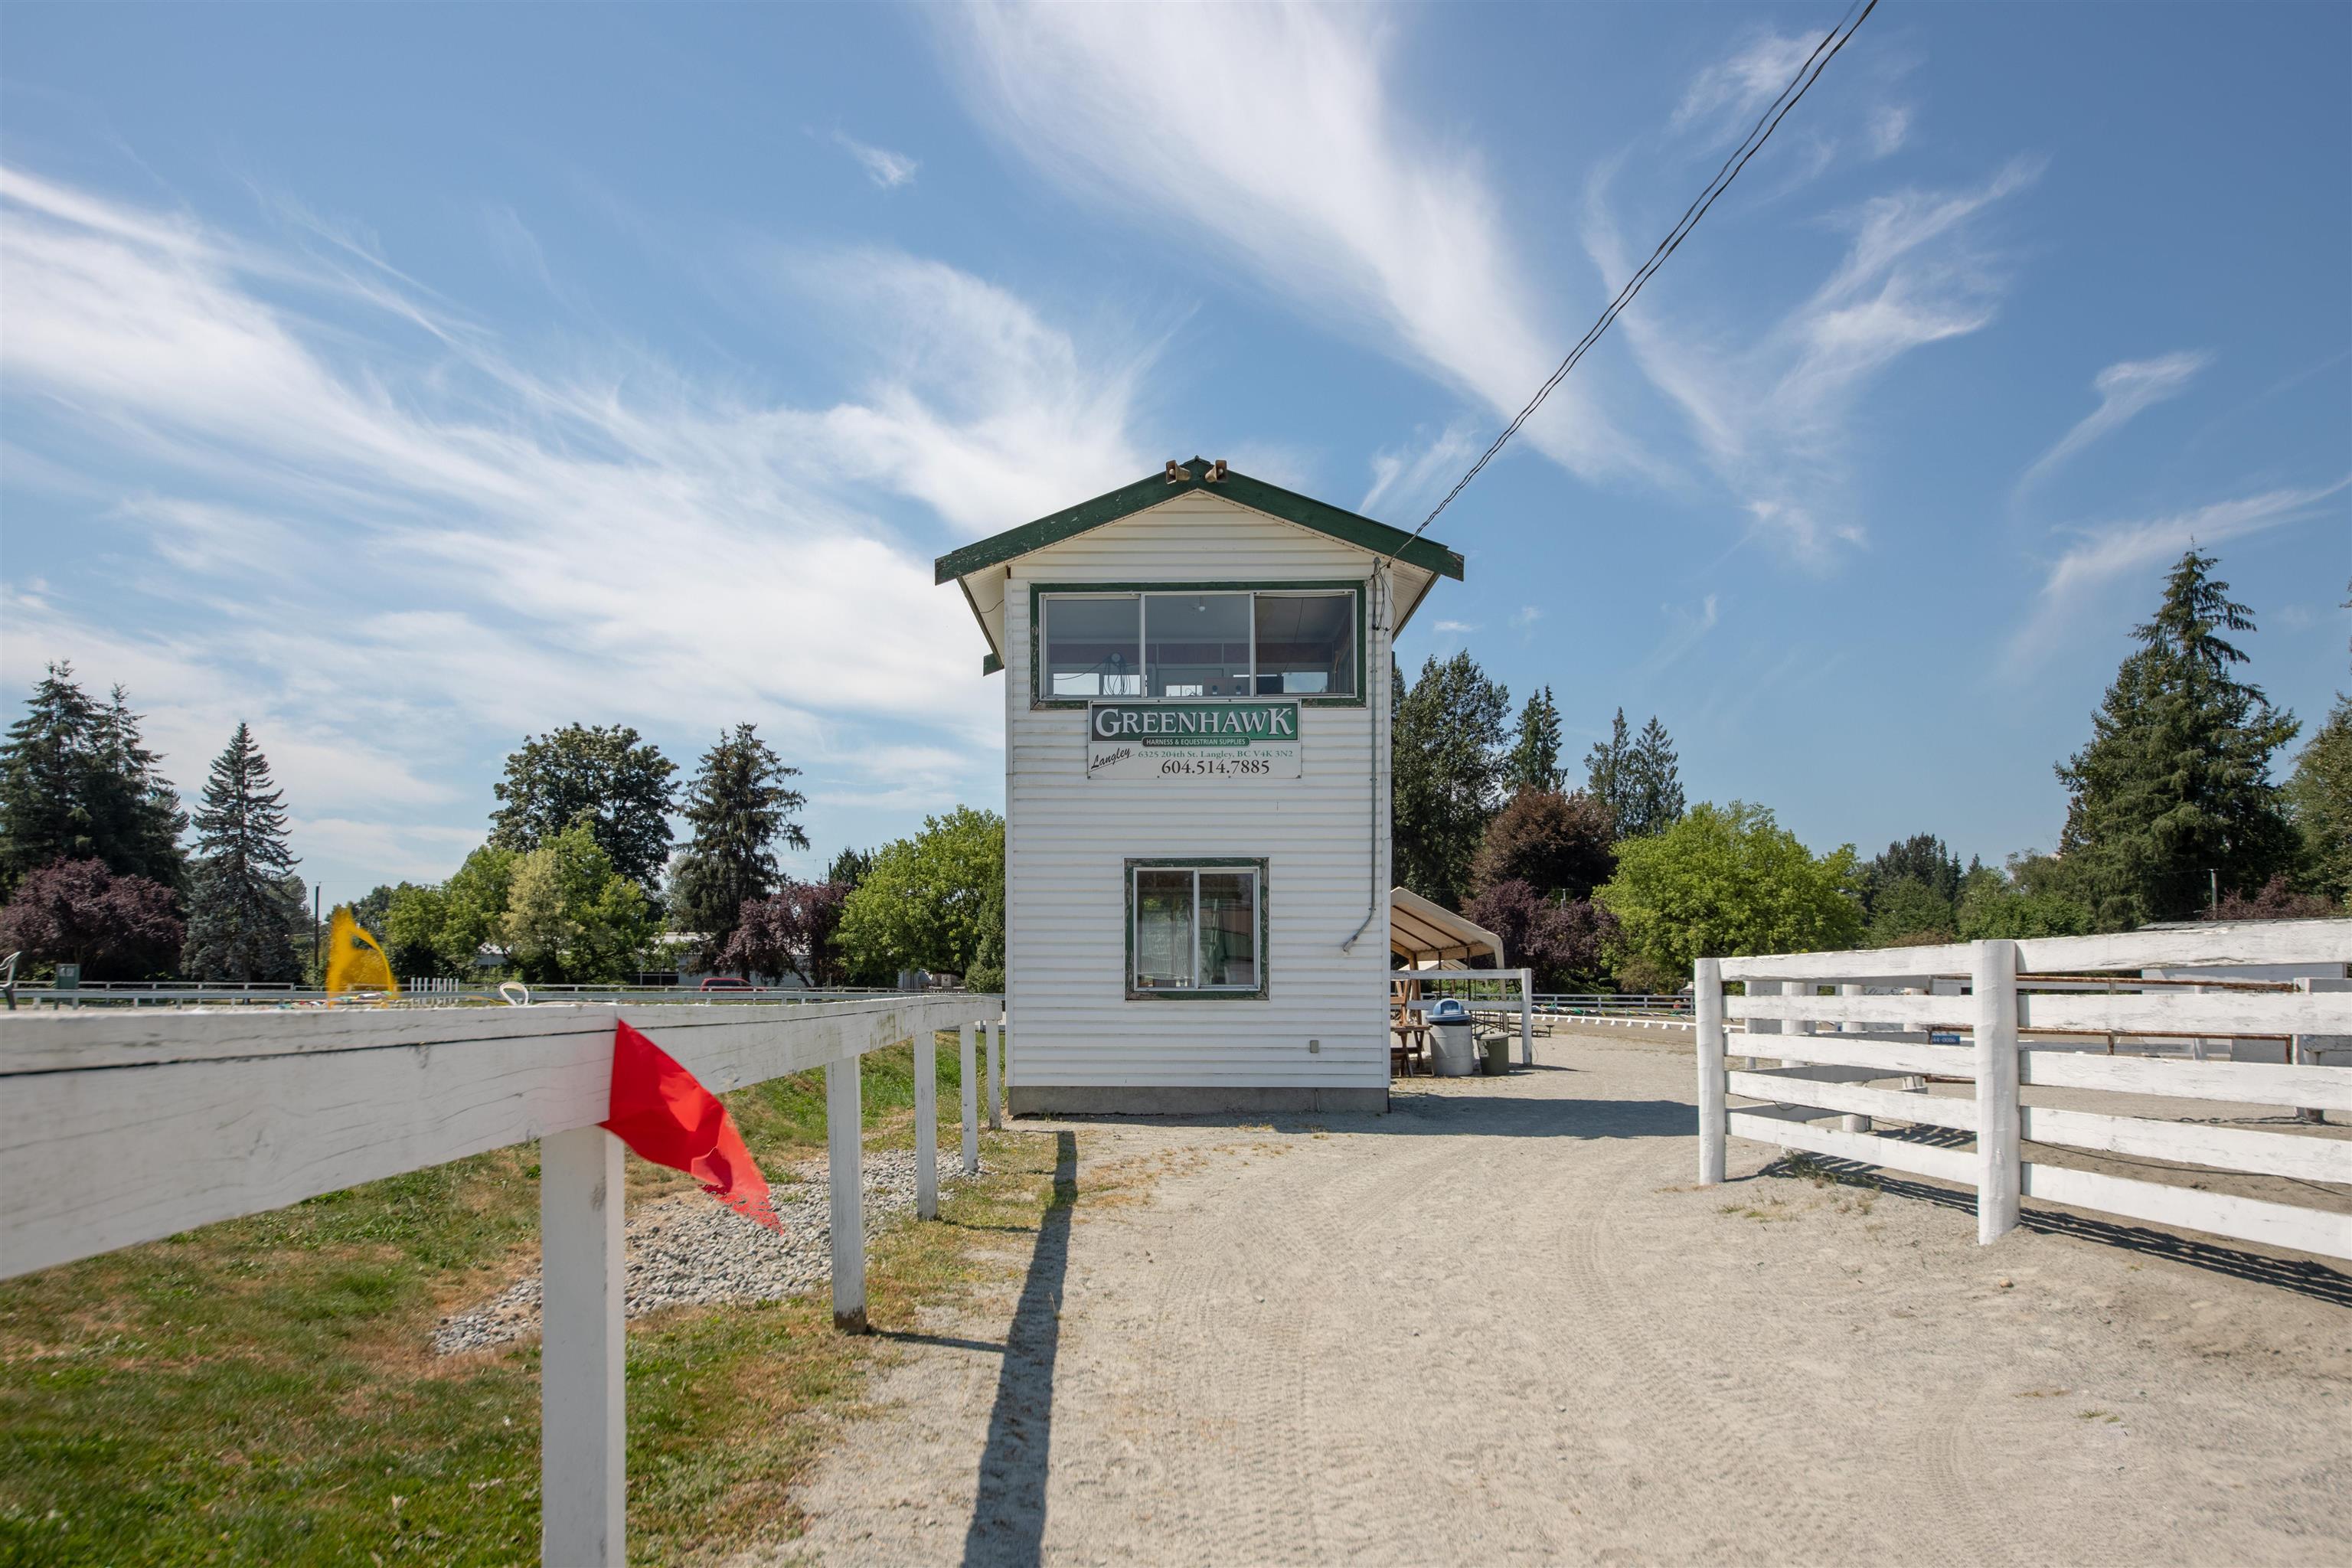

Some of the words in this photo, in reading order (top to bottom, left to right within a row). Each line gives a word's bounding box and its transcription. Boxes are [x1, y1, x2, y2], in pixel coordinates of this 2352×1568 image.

[1096, 708, 1294, 737] GREENHAWK
[1091, 747, 1131, 769] Langley
[1200, 750, 1235, 759] Langley,
[1161, 760, 1269, 775] 604.514.7885
